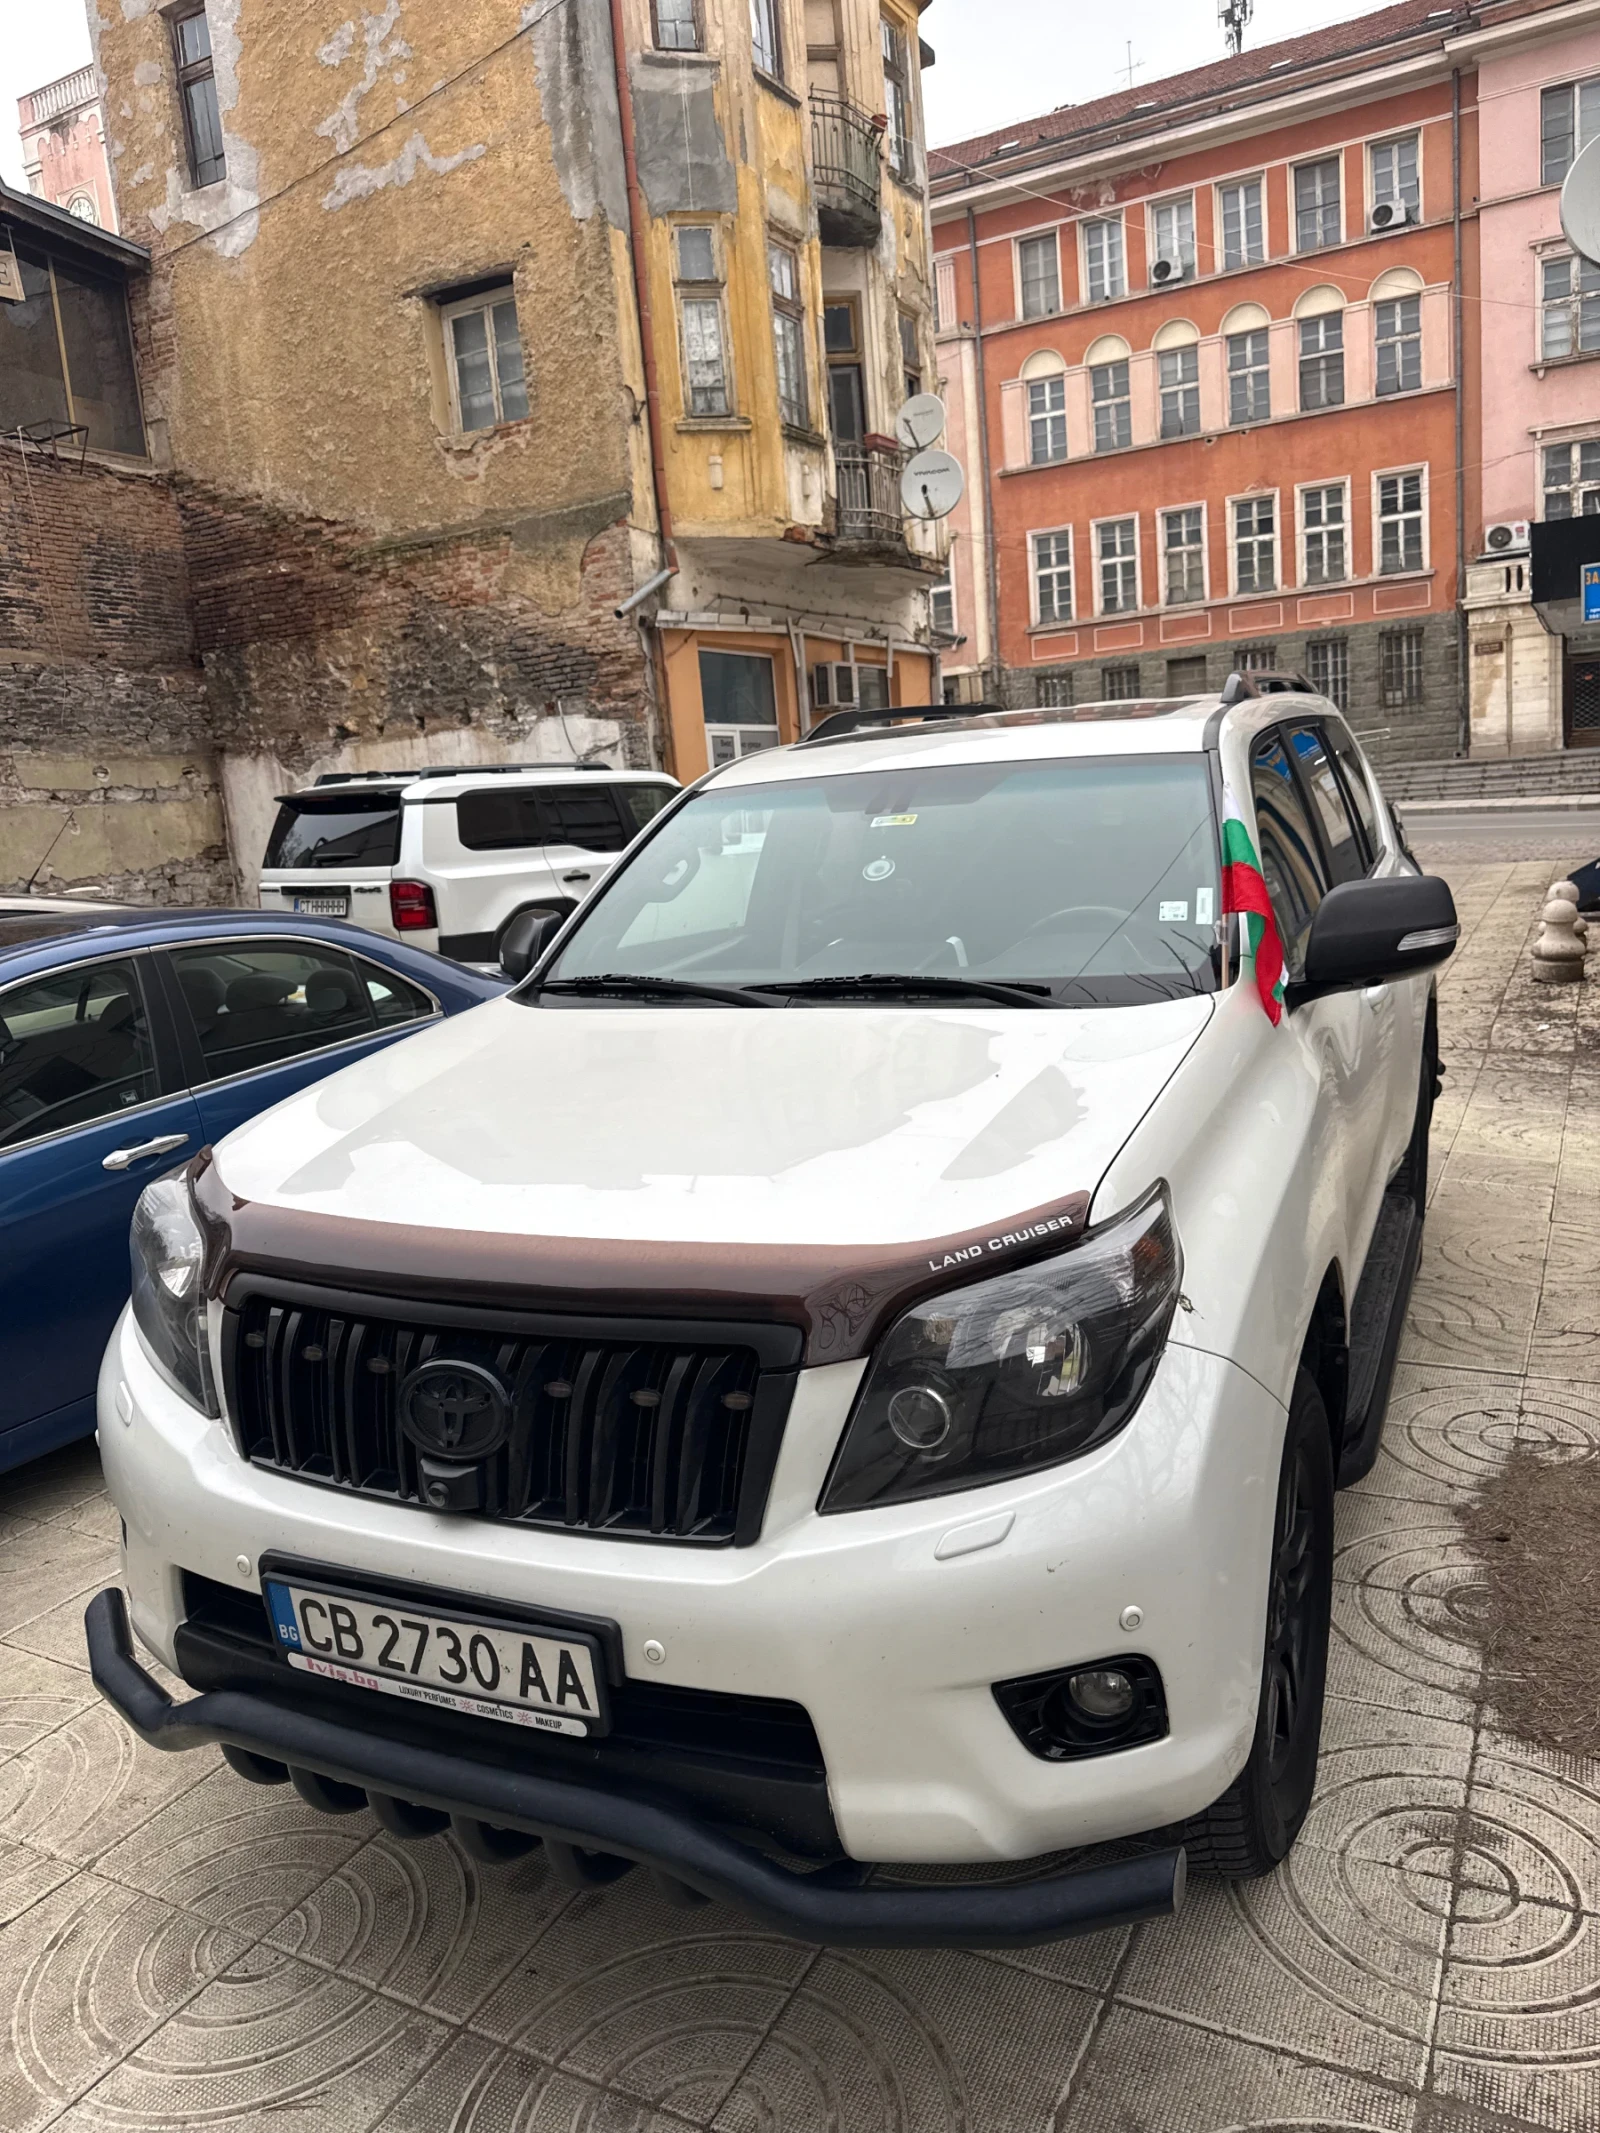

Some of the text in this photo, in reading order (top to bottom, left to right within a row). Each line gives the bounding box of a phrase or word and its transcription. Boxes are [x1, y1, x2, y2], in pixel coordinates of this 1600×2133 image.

[928, 1215, 1073, 1272] LAND CRUISER
[278, 1598, 591, 1710] BG CB 2730 AA
[399, 1685, 562, 1730] LUXURY PERFUMES COSMETICS MAKEUP
